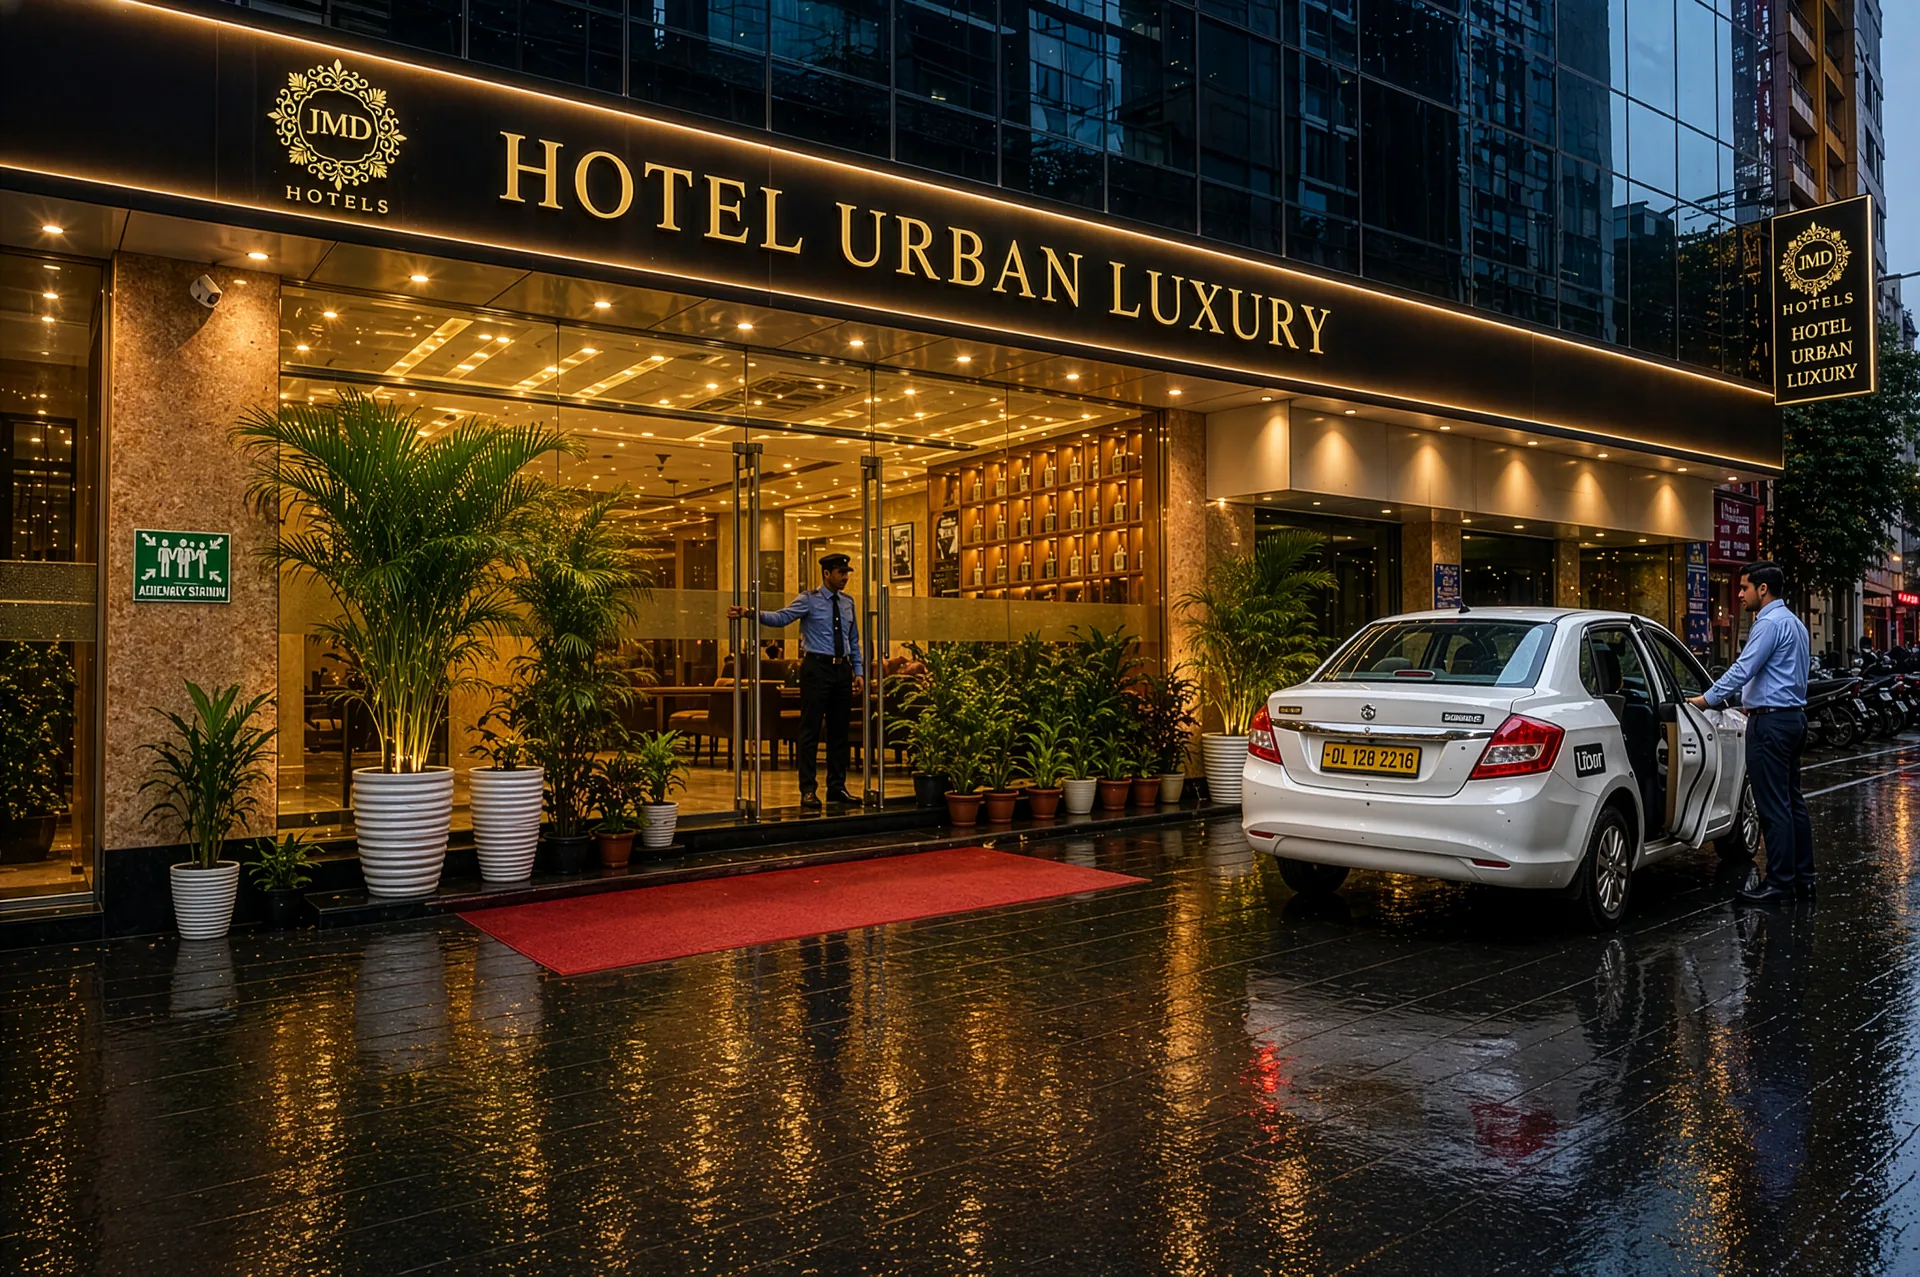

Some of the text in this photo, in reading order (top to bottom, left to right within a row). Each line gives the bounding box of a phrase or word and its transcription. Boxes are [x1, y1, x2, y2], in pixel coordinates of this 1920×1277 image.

[306, 108, 372, 140] JMD
[285, 184, 389, 214] HOTELS
[499, 130, 1331, 355] HOTEL URBAN LUXURY
[1798, 250, 1833, 271] JMD
[1782, 291, 1854, 316] HOTELS
[1791, 317, 1852, 342] HOTEL
[1791, 340, 1853, 365] URBAN
[1786, 362, 1858, 388] LUXURY
[1379, 750, 1414, 769] 2216
